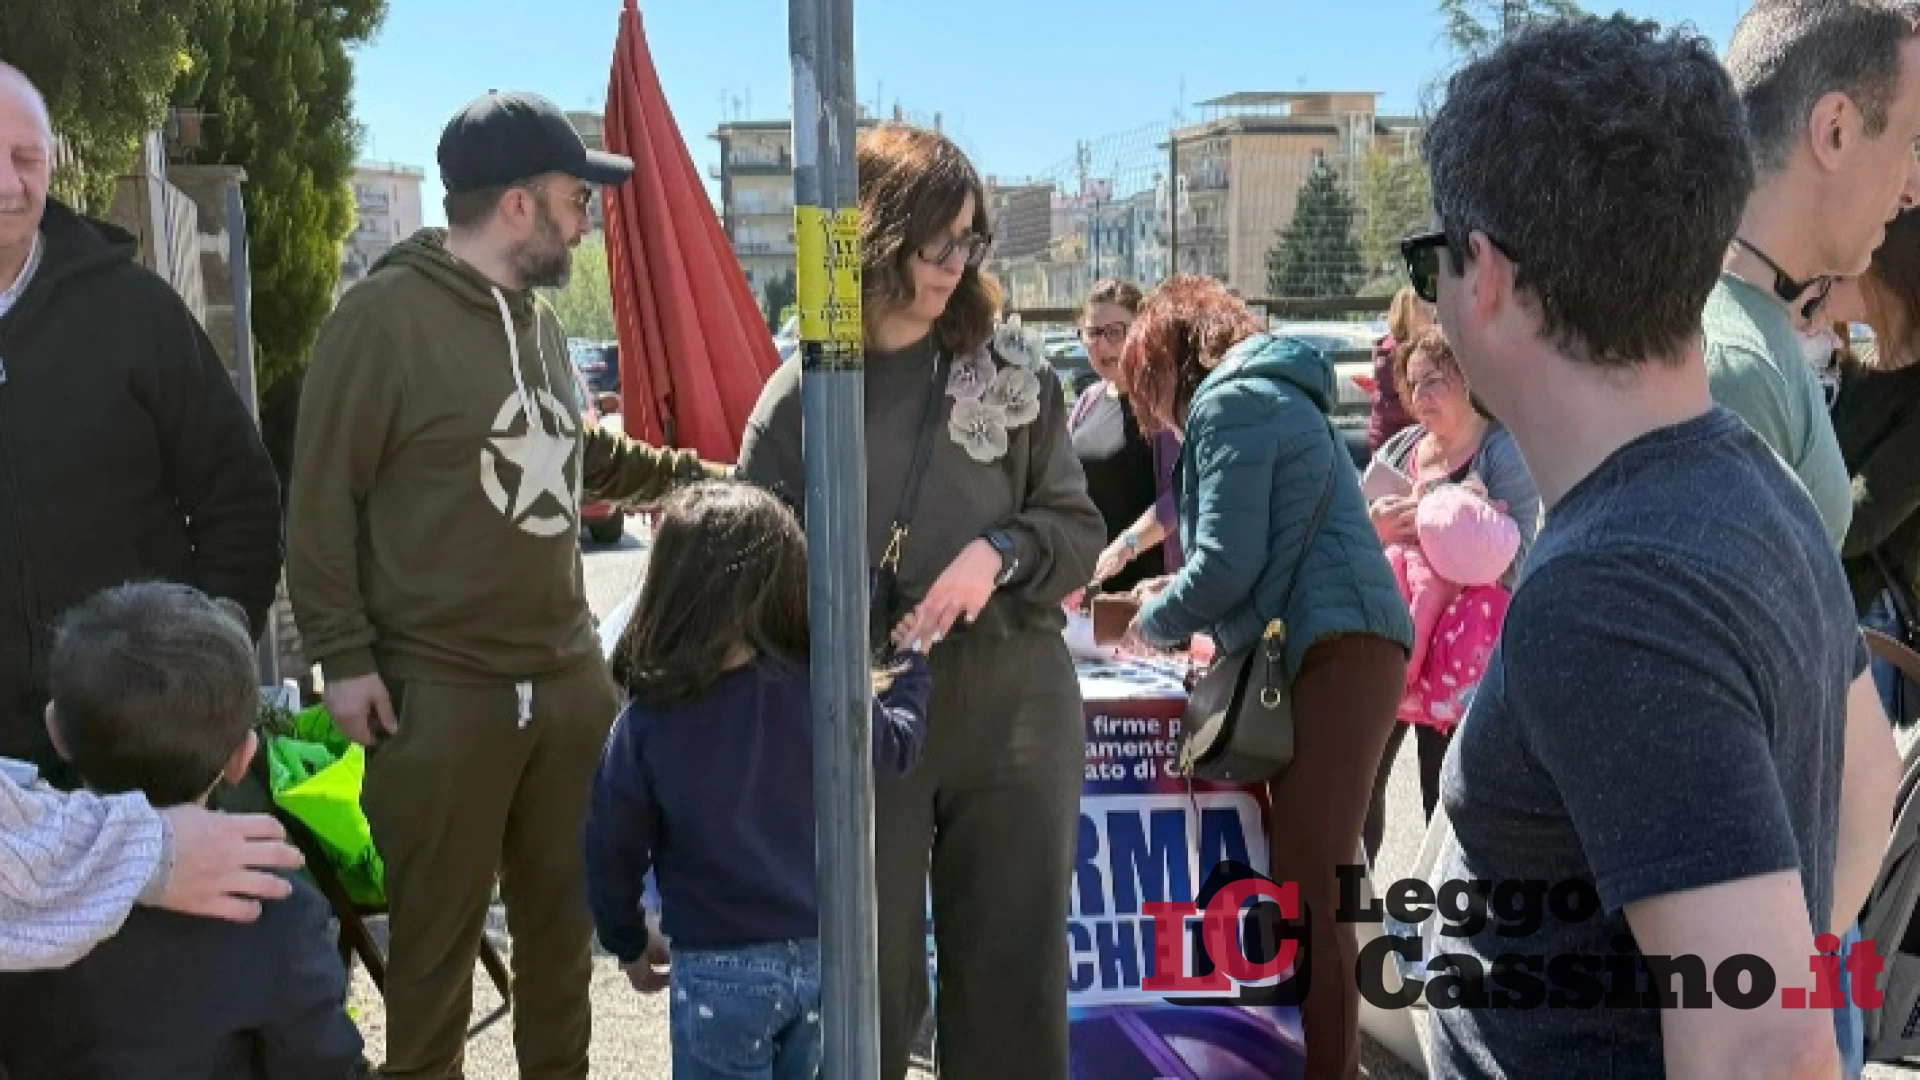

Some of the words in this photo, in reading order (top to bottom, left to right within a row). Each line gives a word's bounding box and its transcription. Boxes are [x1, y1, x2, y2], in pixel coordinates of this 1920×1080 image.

[1093, 715, 1161, 736] firme
[1168, 717, 1181, 738] p
[1085, 739, 1178, 758] amento
[1085, 759, 1126, 780] ato
[1134, 758, 1156, 780] di
[1163, 758, 1181, 778] C
[1072, 808, 1257, 916] RMA
[1067, 918, 1177, 991] CHE
